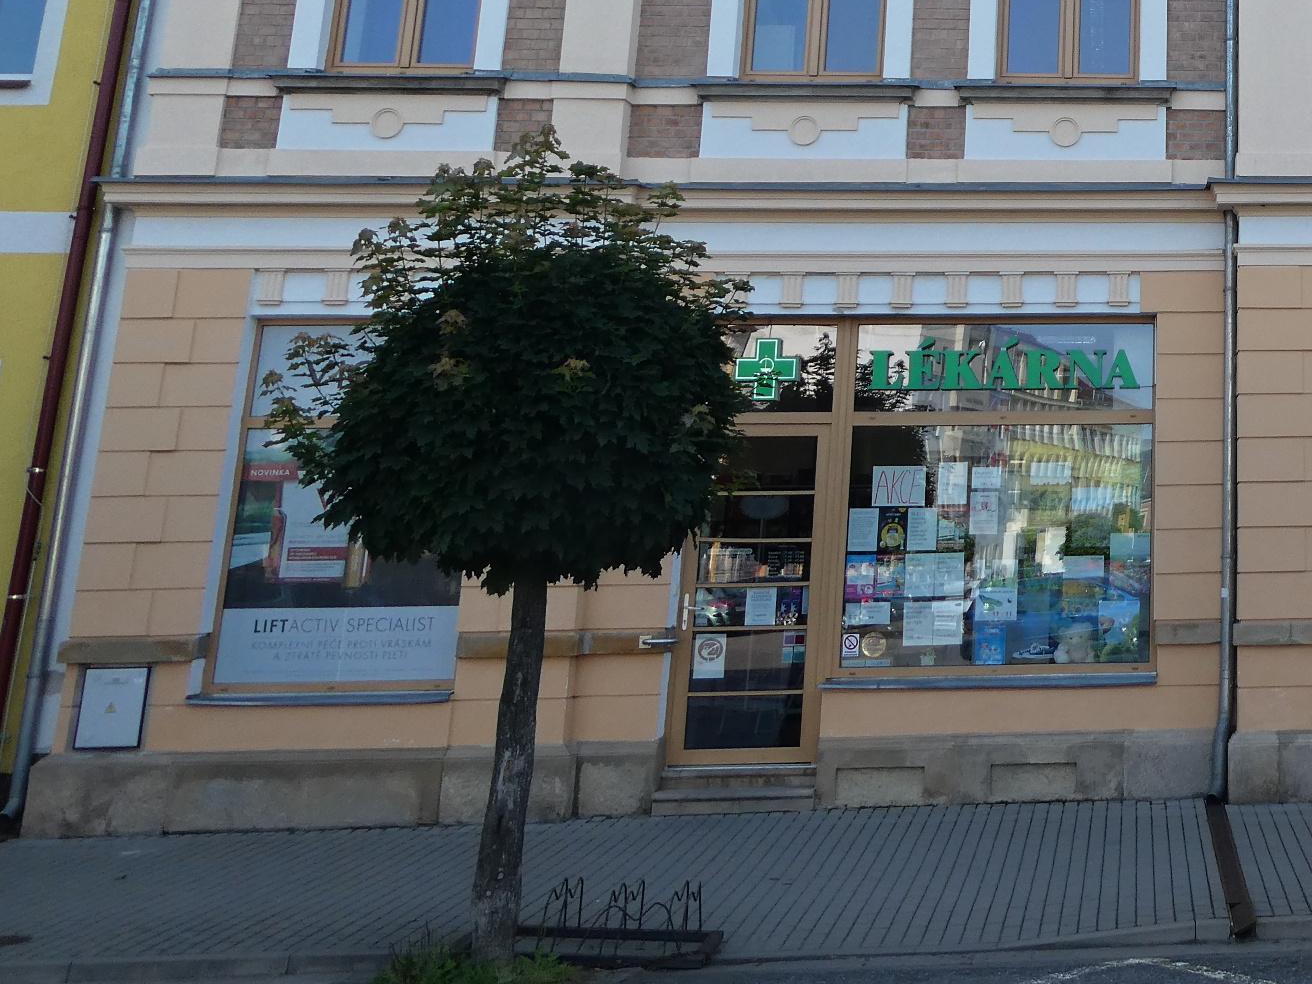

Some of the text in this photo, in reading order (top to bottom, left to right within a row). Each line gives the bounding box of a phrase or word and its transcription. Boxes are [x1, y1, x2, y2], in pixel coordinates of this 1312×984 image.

[869, 336, 1141, 391] LÉKÁRNA
[250, 469, 291, 477] NOVINKA
[874, 468, 924, 505] AKCE
[346, 616, 435, 633] SPECIALIST
